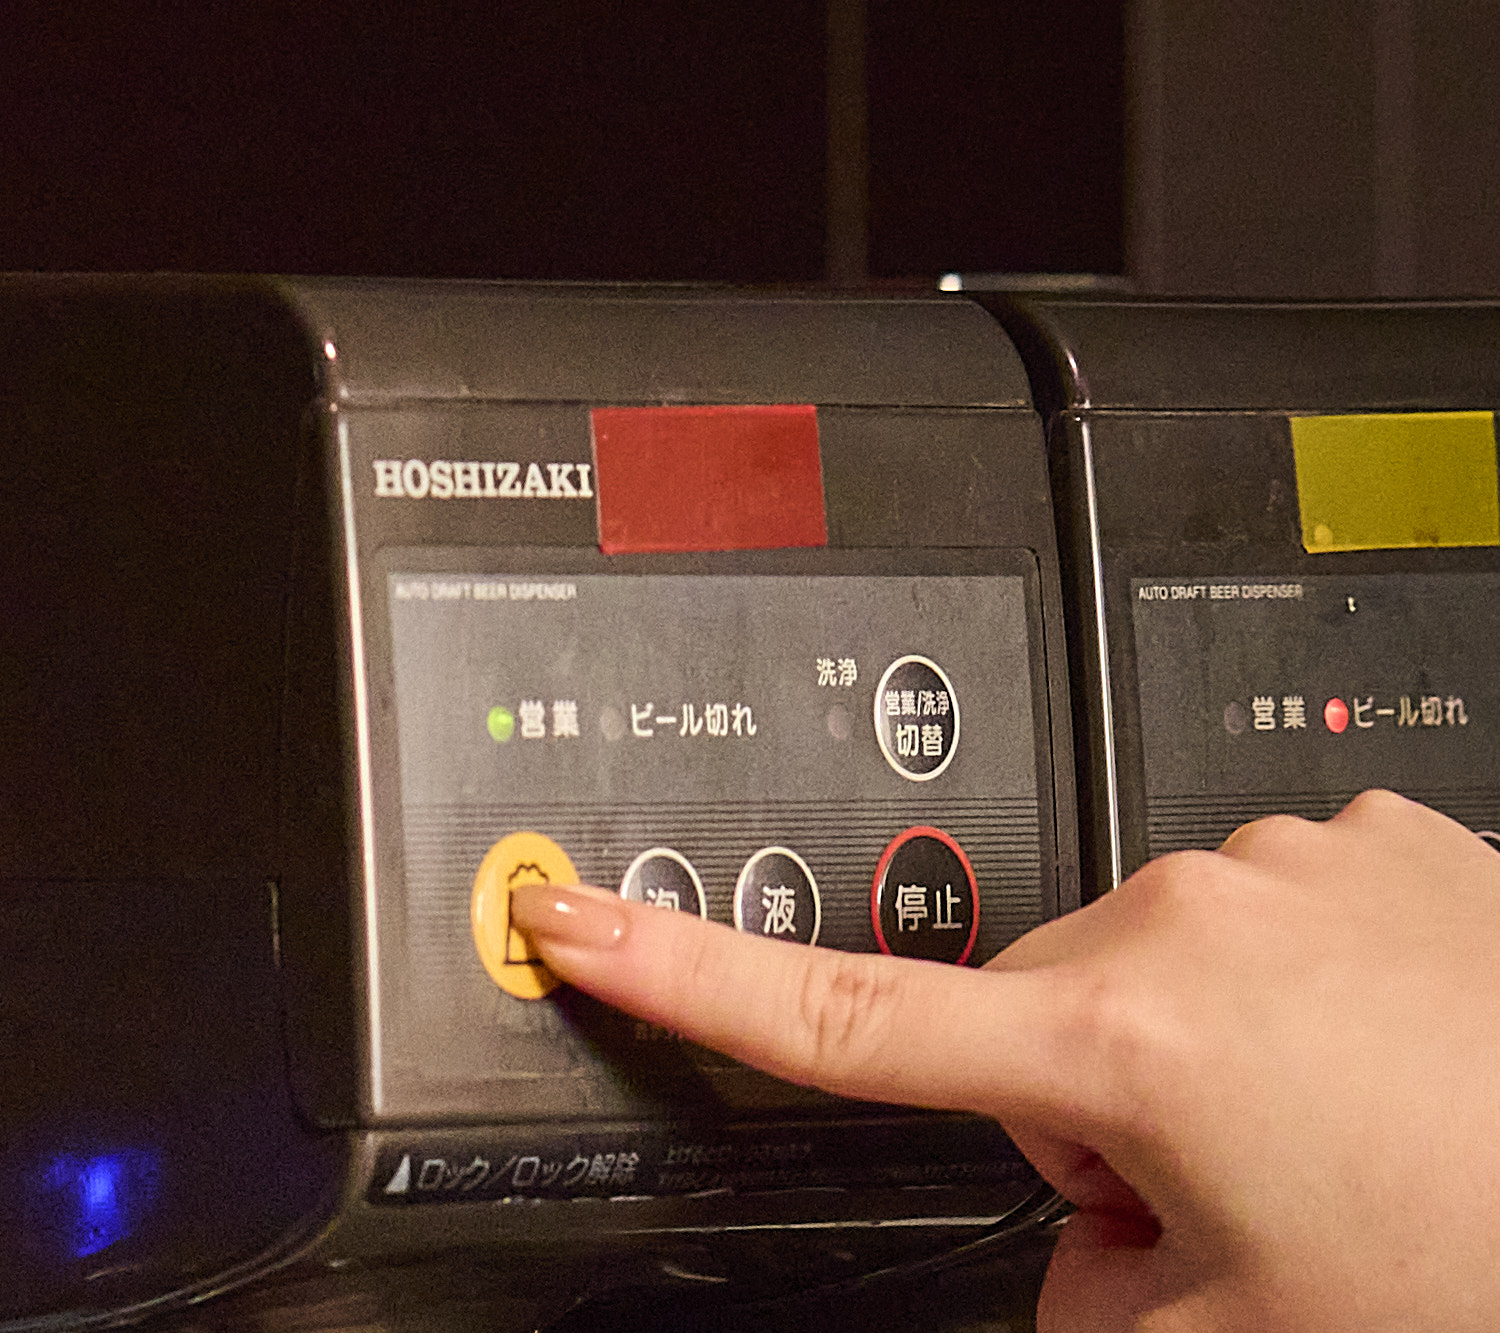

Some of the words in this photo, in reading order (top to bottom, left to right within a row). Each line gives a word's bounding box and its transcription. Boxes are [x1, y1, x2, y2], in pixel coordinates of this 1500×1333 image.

[373, 459, 594, 499] HOSHIZAKI
[1138, 586, 1168, 600] AUTO
[1170, 584, 1207, 600] DRAFT
[1209, 584, 1240, 600] BEER
[1241, 583, 1304, 600] DISPENSER
[815, 657, 859, 688] 洗浄
[519, 701, 580, 738] 営業
[630, 701, 758, 738] ビール切れ
[1251, 695, 1307, 731] 営業
[1352, 695, 1470, 730] ビール切れ
[895, 723, 944, 757] 切替
[761, 885, 797, 934] 液
[893, 883, 963, 934] 停止
